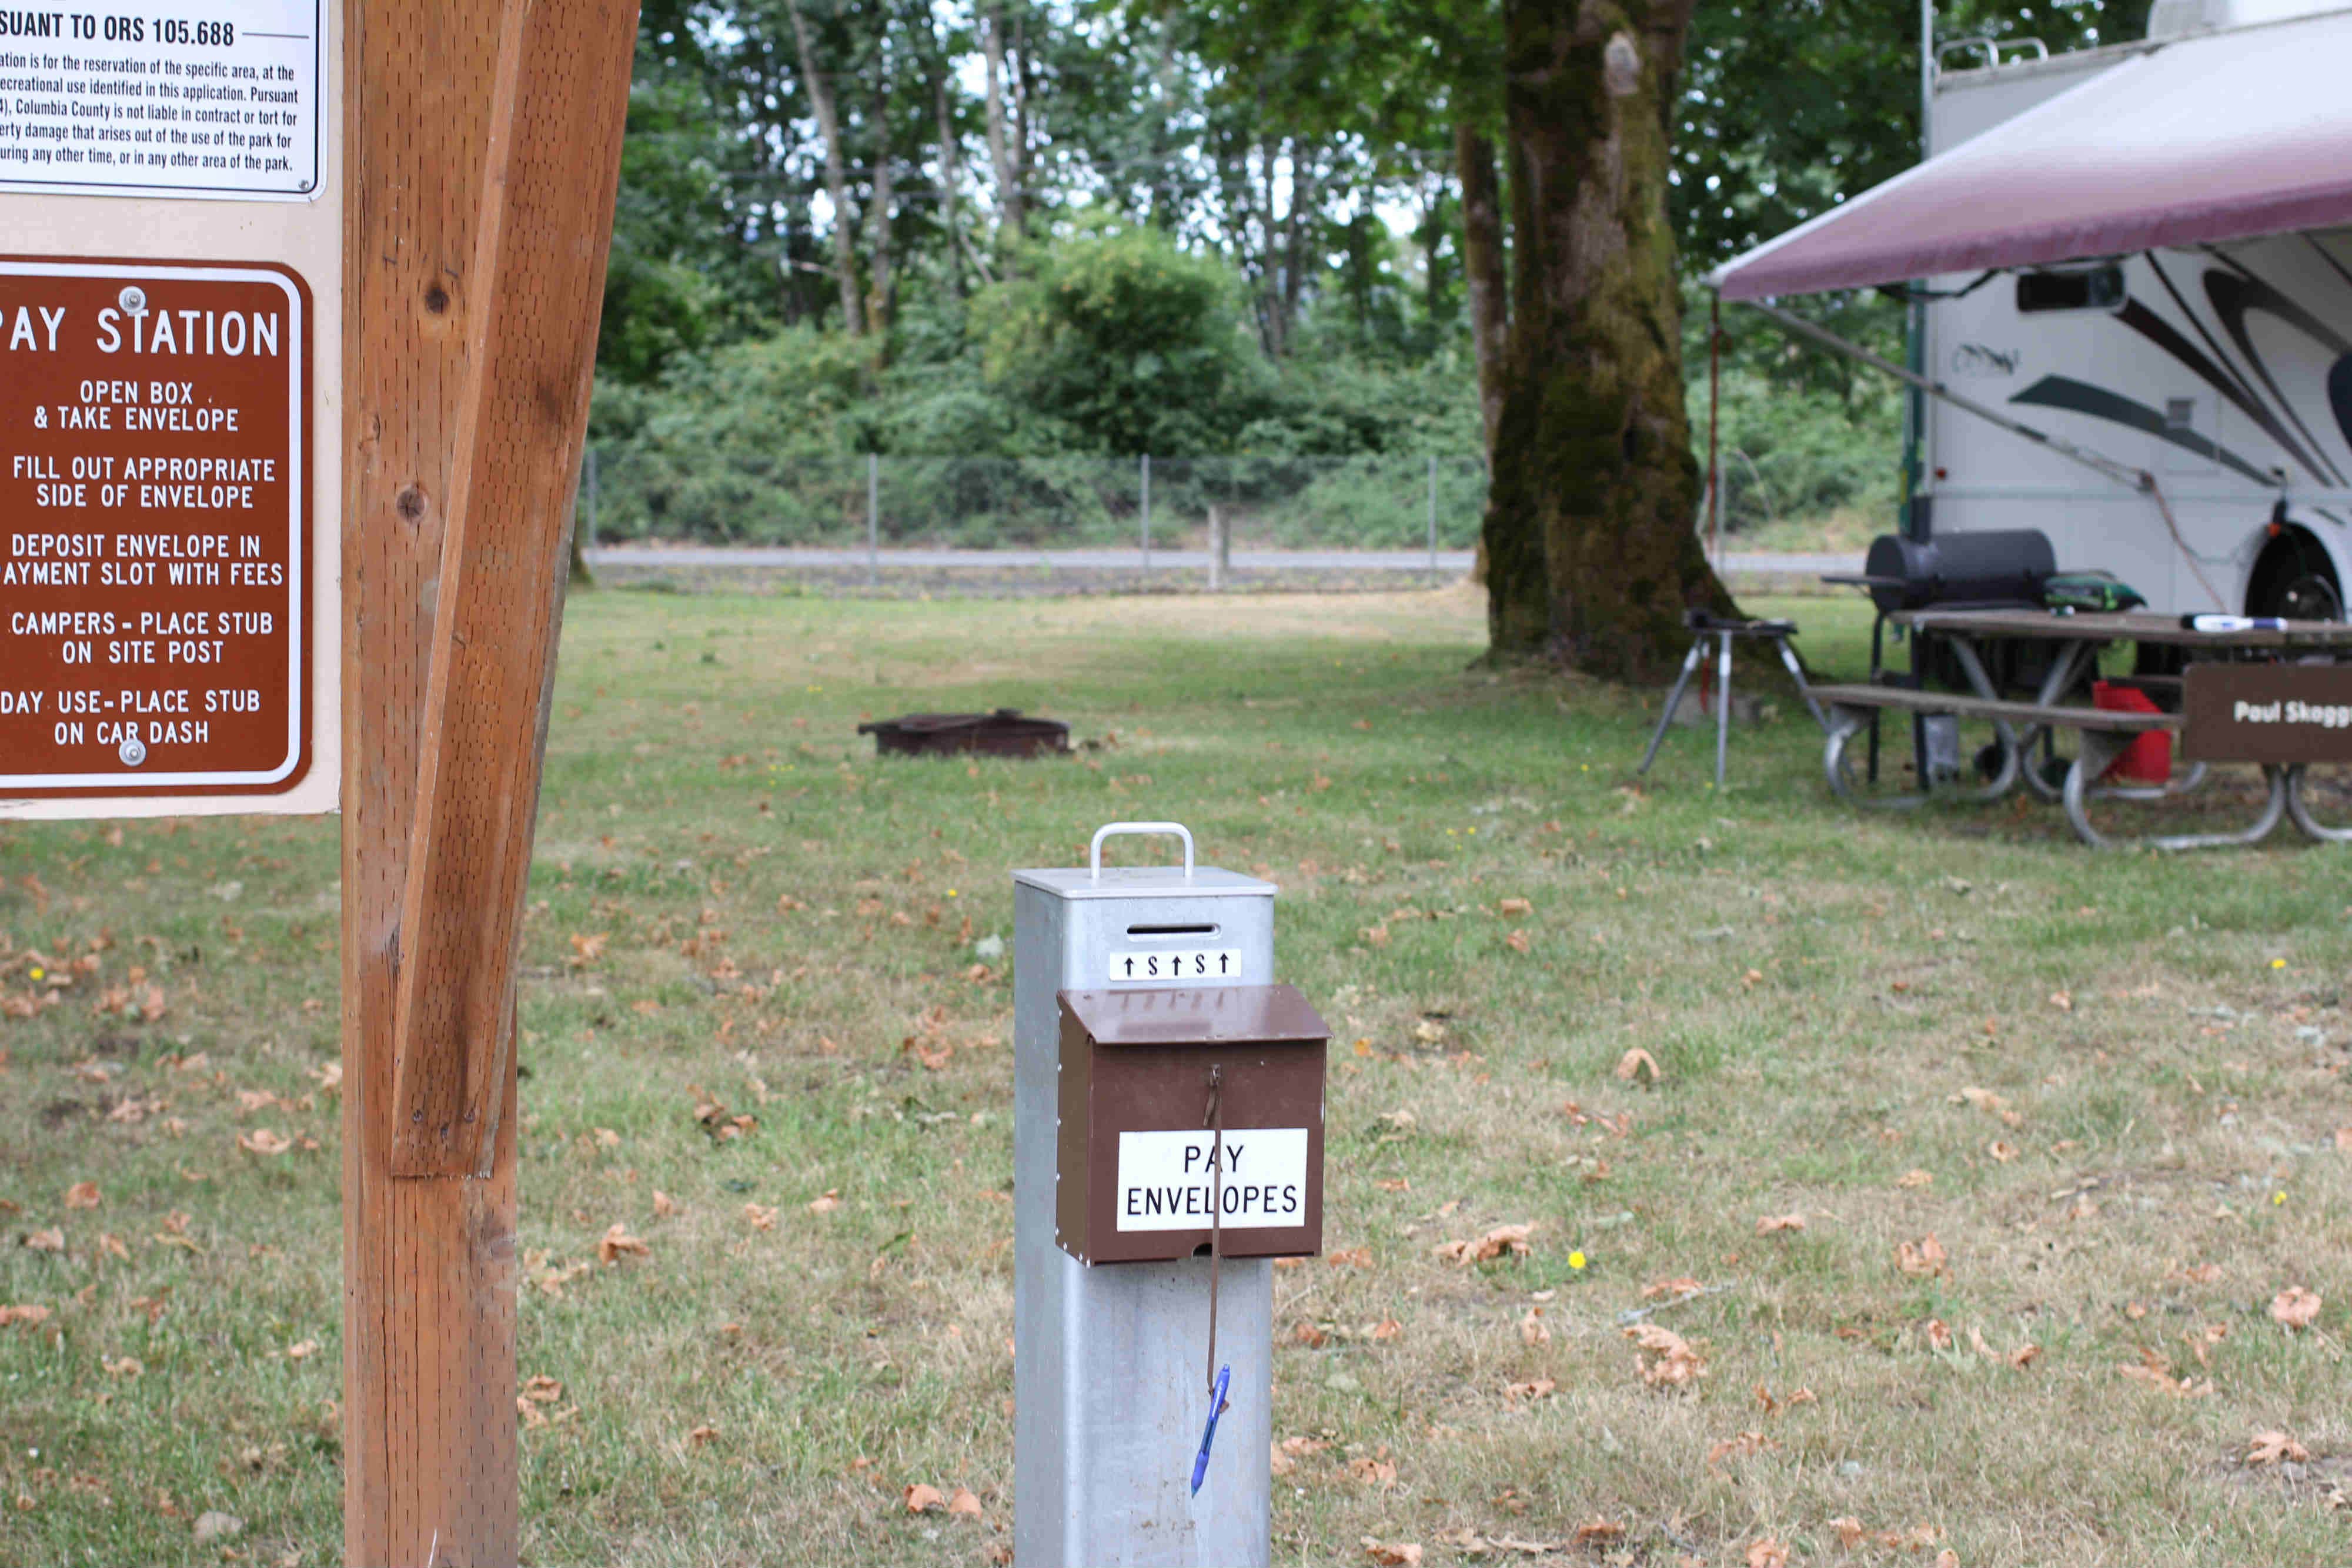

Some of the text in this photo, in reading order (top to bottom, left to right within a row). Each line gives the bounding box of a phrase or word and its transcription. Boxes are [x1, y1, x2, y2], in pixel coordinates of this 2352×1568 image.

[0, 10, 234, 46] SUANT TO ORS 105.688
[30, 53, 39, 69] is
[43, 54, 58, 69] for
[62, 55, 80, 70] the
[84, 58, 146, 73] reservation
[150, 59, 161, 74] of
[165, 61, 182, 75] the
[185, 62, 228, 79] specific
[232, 66, 259, 81] area,
[263, 65, 273, 79] at
[278, 65, 294, 81] the
[0, 76, 298, 103] ecreational use identified in this application. Pursuant
[16, 98, 68, 116] Columbia
[71, 101, 110, 121] County
[114, 103, 123, 118] is
[127, 105, 144, 119] not
[148, 104, 178, 121] liable
[182, 106, 191, 121] in
[195, 108, 240, 123] contract
[244, 112, 255, 124] or
[259, 111, 278, 125] tort
[282, 111, 297, 126] for
[0, 122, 292, 150] erty damage that arises out of the use of the park for
[0, 145, 292, 173] uring any other time, or in any other area of the park.
[0, 306, 278, 356] AY STATION
[80, 380, 193, 405] OPEN BOX
[34, 406, 238, 432] & TAKE ENVELOPE
[14, 456, 275, 482] FILL OUT APPROPRIATE
[36, 483, 253, 509] SIDE OF ENVELOPE
[12, 534, 259, 557] DEPOSIT ENVELOPE IN
[0, 561, 282, 586] AYMENT SLOT WITH FEES
[218, 612, 272, 634] STUB
[62, 640, 223, 664] ON SITE POST
[1, 691, 43, 714] DAY
[205, 690, 260, 712] STUB
[2234, 700, 2352, 728] Paul Skagg
[55, 721, 208, 745] ON CAR DASH
[1184, 1145, 1244, 1172] PAY
[1127, 1185, 1297, 1215] ENVELOPES
